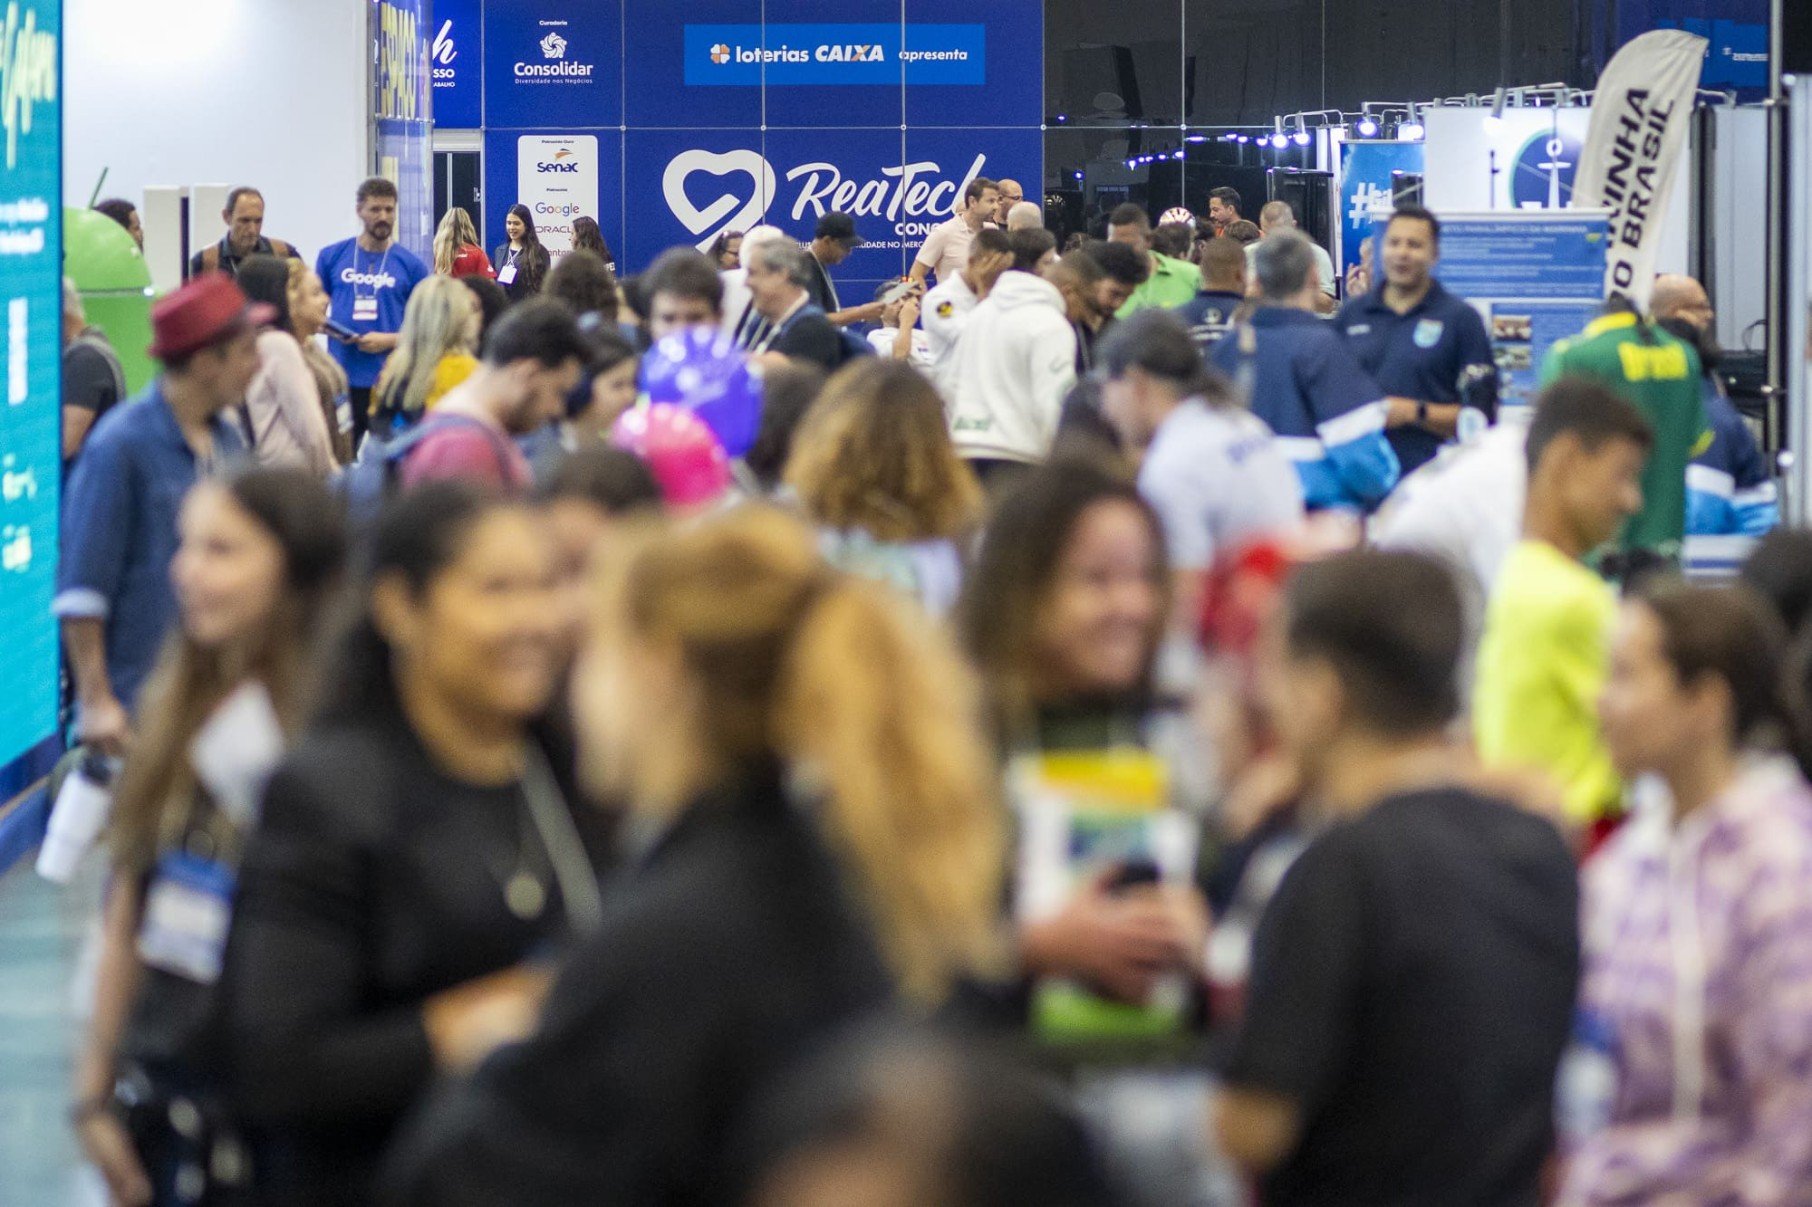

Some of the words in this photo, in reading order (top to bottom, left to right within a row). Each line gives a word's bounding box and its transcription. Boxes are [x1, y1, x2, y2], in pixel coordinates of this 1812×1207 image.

[736, 45, 809, 63] loterias
[815, 45, 885, 62] CAIXA
[899, 48, 968, 63] apresenta
[514, 61, 594, 76] Consolidar
[1621, 99, 1675, 249] BRASIL
[535, 202, 580, 217] Google
[535, 225, 573, 233] ORACL
[341, 267, 396, 289] Google
